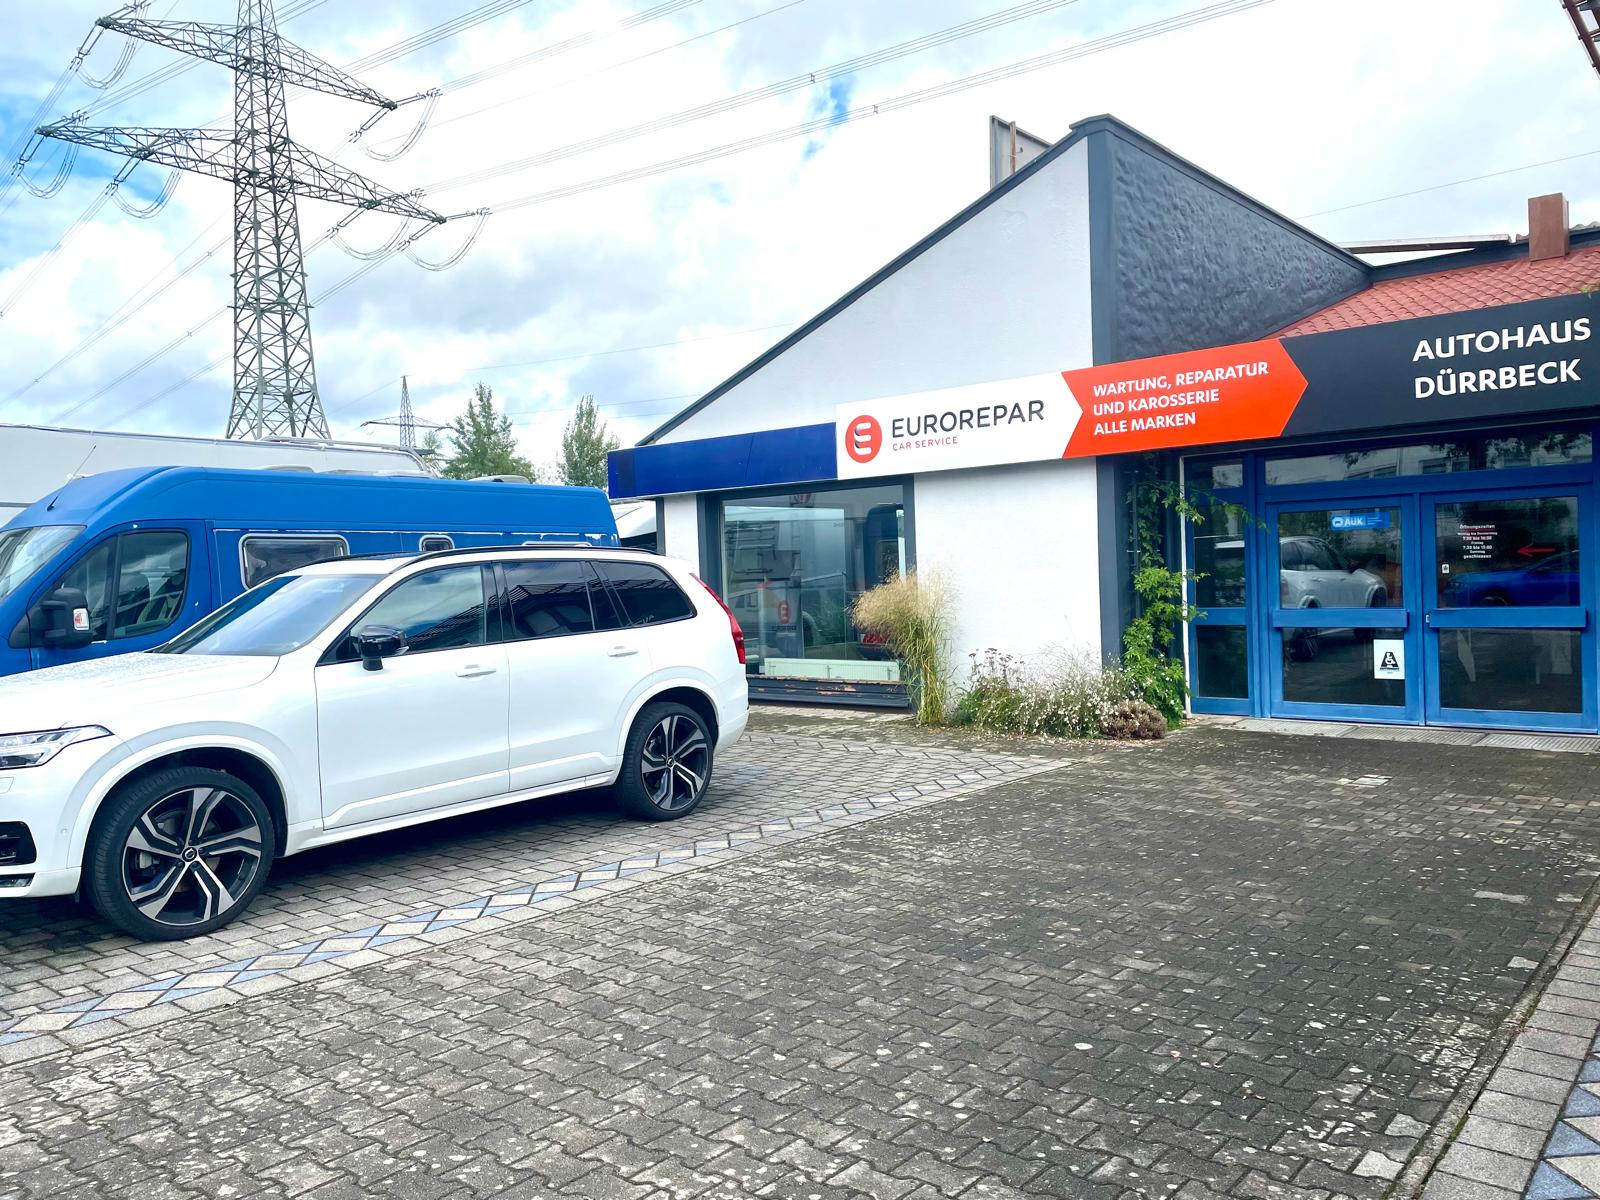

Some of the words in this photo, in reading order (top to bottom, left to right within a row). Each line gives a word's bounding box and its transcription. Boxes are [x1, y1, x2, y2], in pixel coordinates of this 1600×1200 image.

[1412, 317, 1592, 362] AUTOHAUS
[1093, 375, 1172, 398] WARTUNG,
[1175, 361, 1269, 387] REPARATUR
[1414, 358, 1582, 399] DÜRRBECK
[892, 399, 1045, 439] EUROREPAR
[1093, 401, 1125, 416] UND
[1128, 388, 1220, 412] KAROSSERIE
[1094, 419, 1128, 436] ALLE
[1131, 411, 1197, 432] MARKEN
[892, 441, 912, 452] CAR
[915, 436, 959, 449] SERVICE
